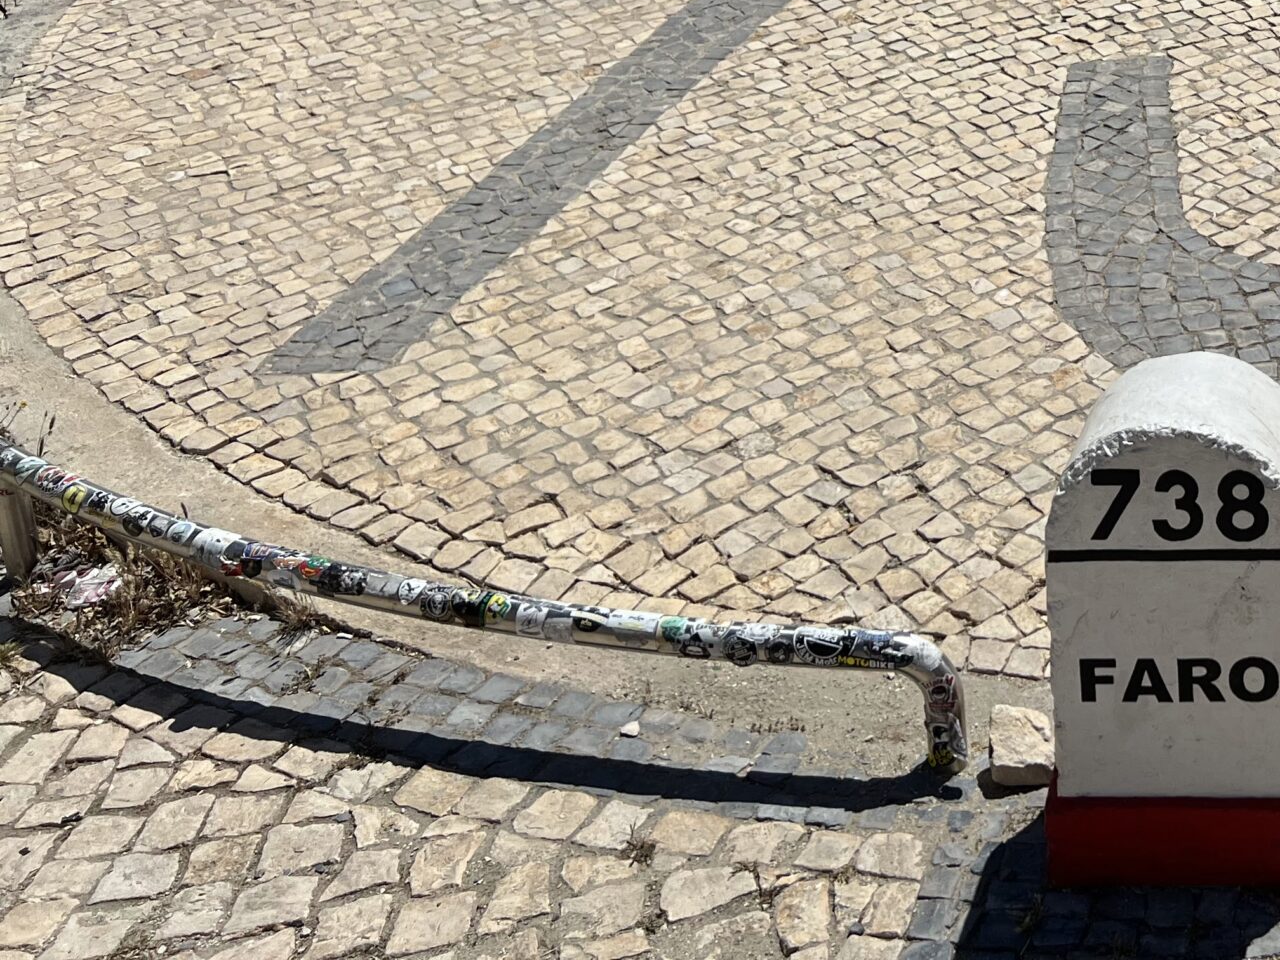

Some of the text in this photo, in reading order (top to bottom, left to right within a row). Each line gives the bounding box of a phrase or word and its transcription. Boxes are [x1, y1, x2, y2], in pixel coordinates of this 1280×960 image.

[1089, 468, 1270, 543] 738
[814, 631, 839, 643] 2023
[838, 655, 896, 670] MOTOBIKE
[1078, 655, 1280, 704] FARO
